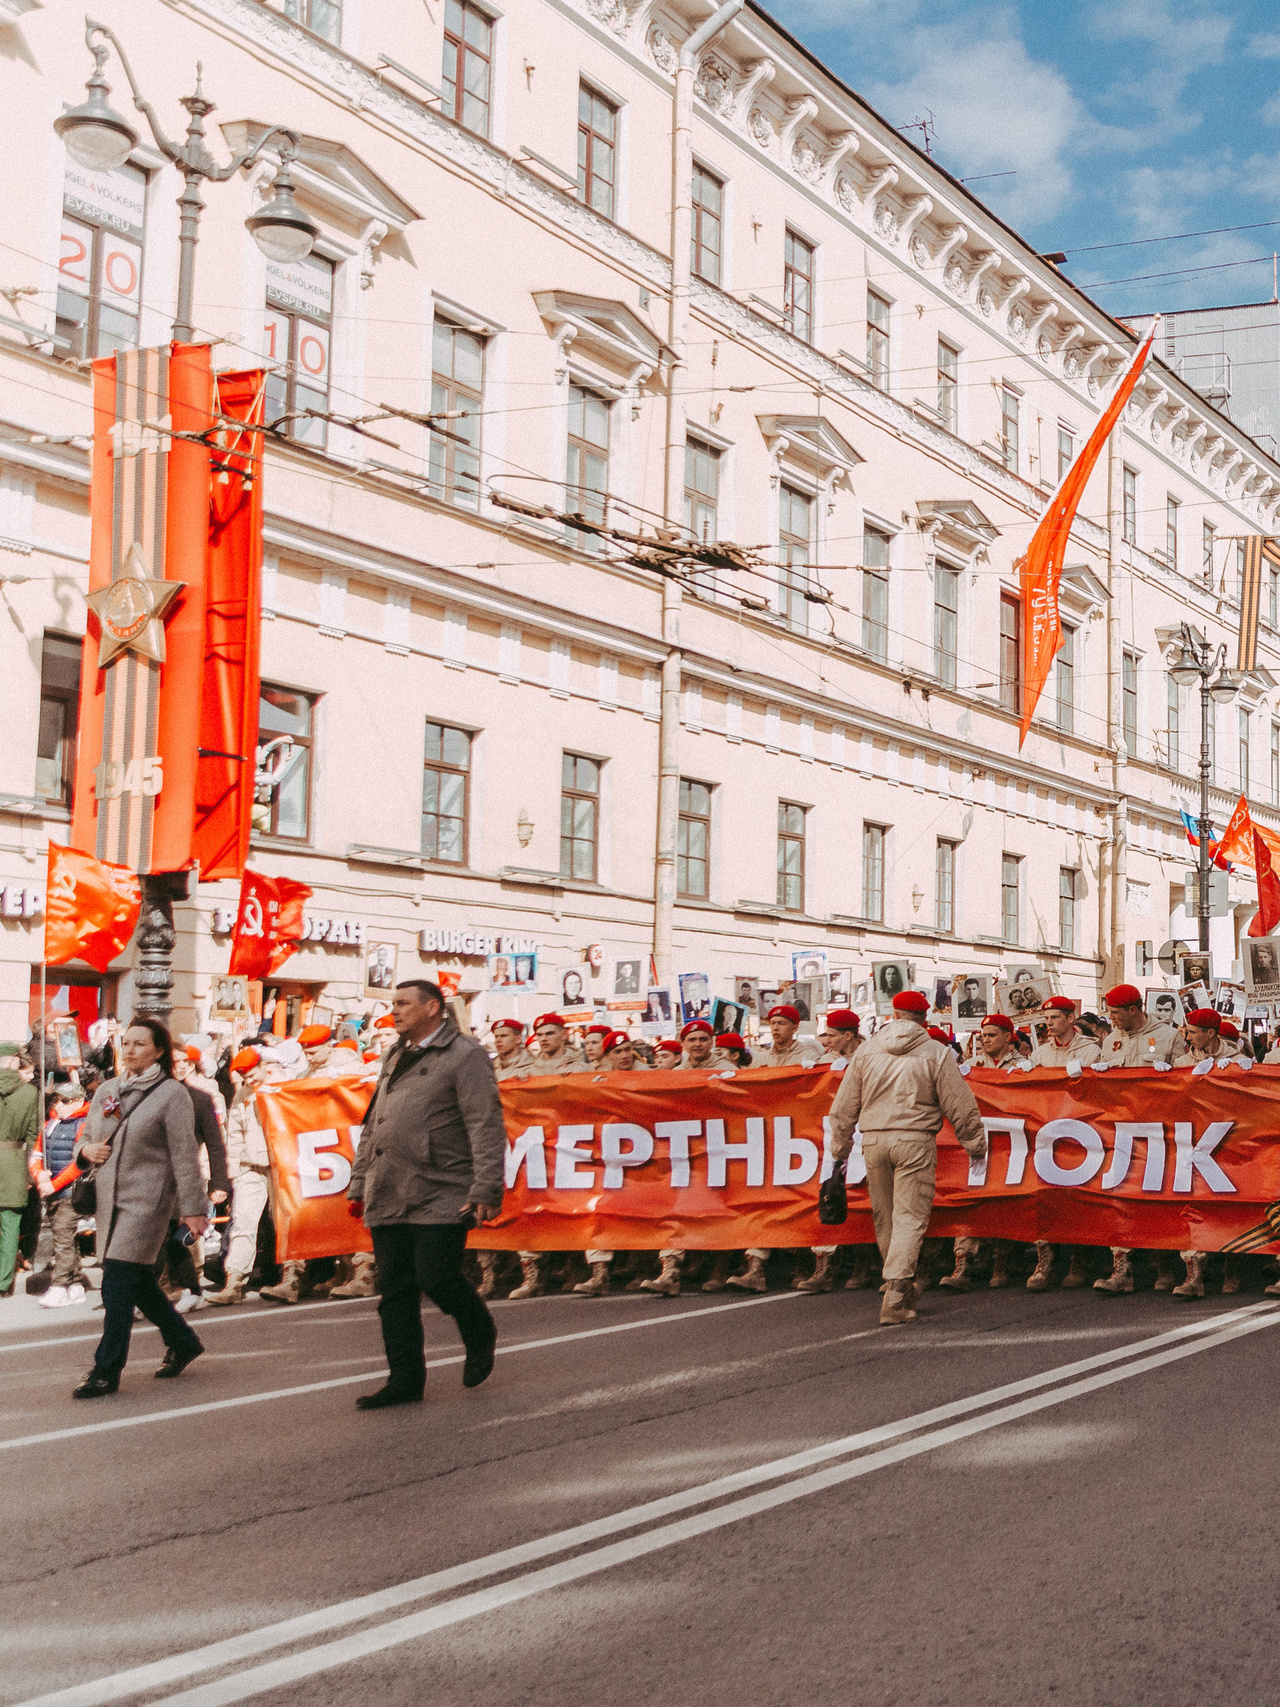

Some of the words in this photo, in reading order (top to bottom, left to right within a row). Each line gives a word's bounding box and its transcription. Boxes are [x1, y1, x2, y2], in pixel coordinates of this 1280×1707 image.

[66, 195, 130, 233] EVSPB.RU
[267, 288, 320, 316] EVSPB.RU
[92, 756, 164, 799] 1945
[419, 929, 496, 957] BURGER
[967, 1116, 1238, 1193] ПОЛК
